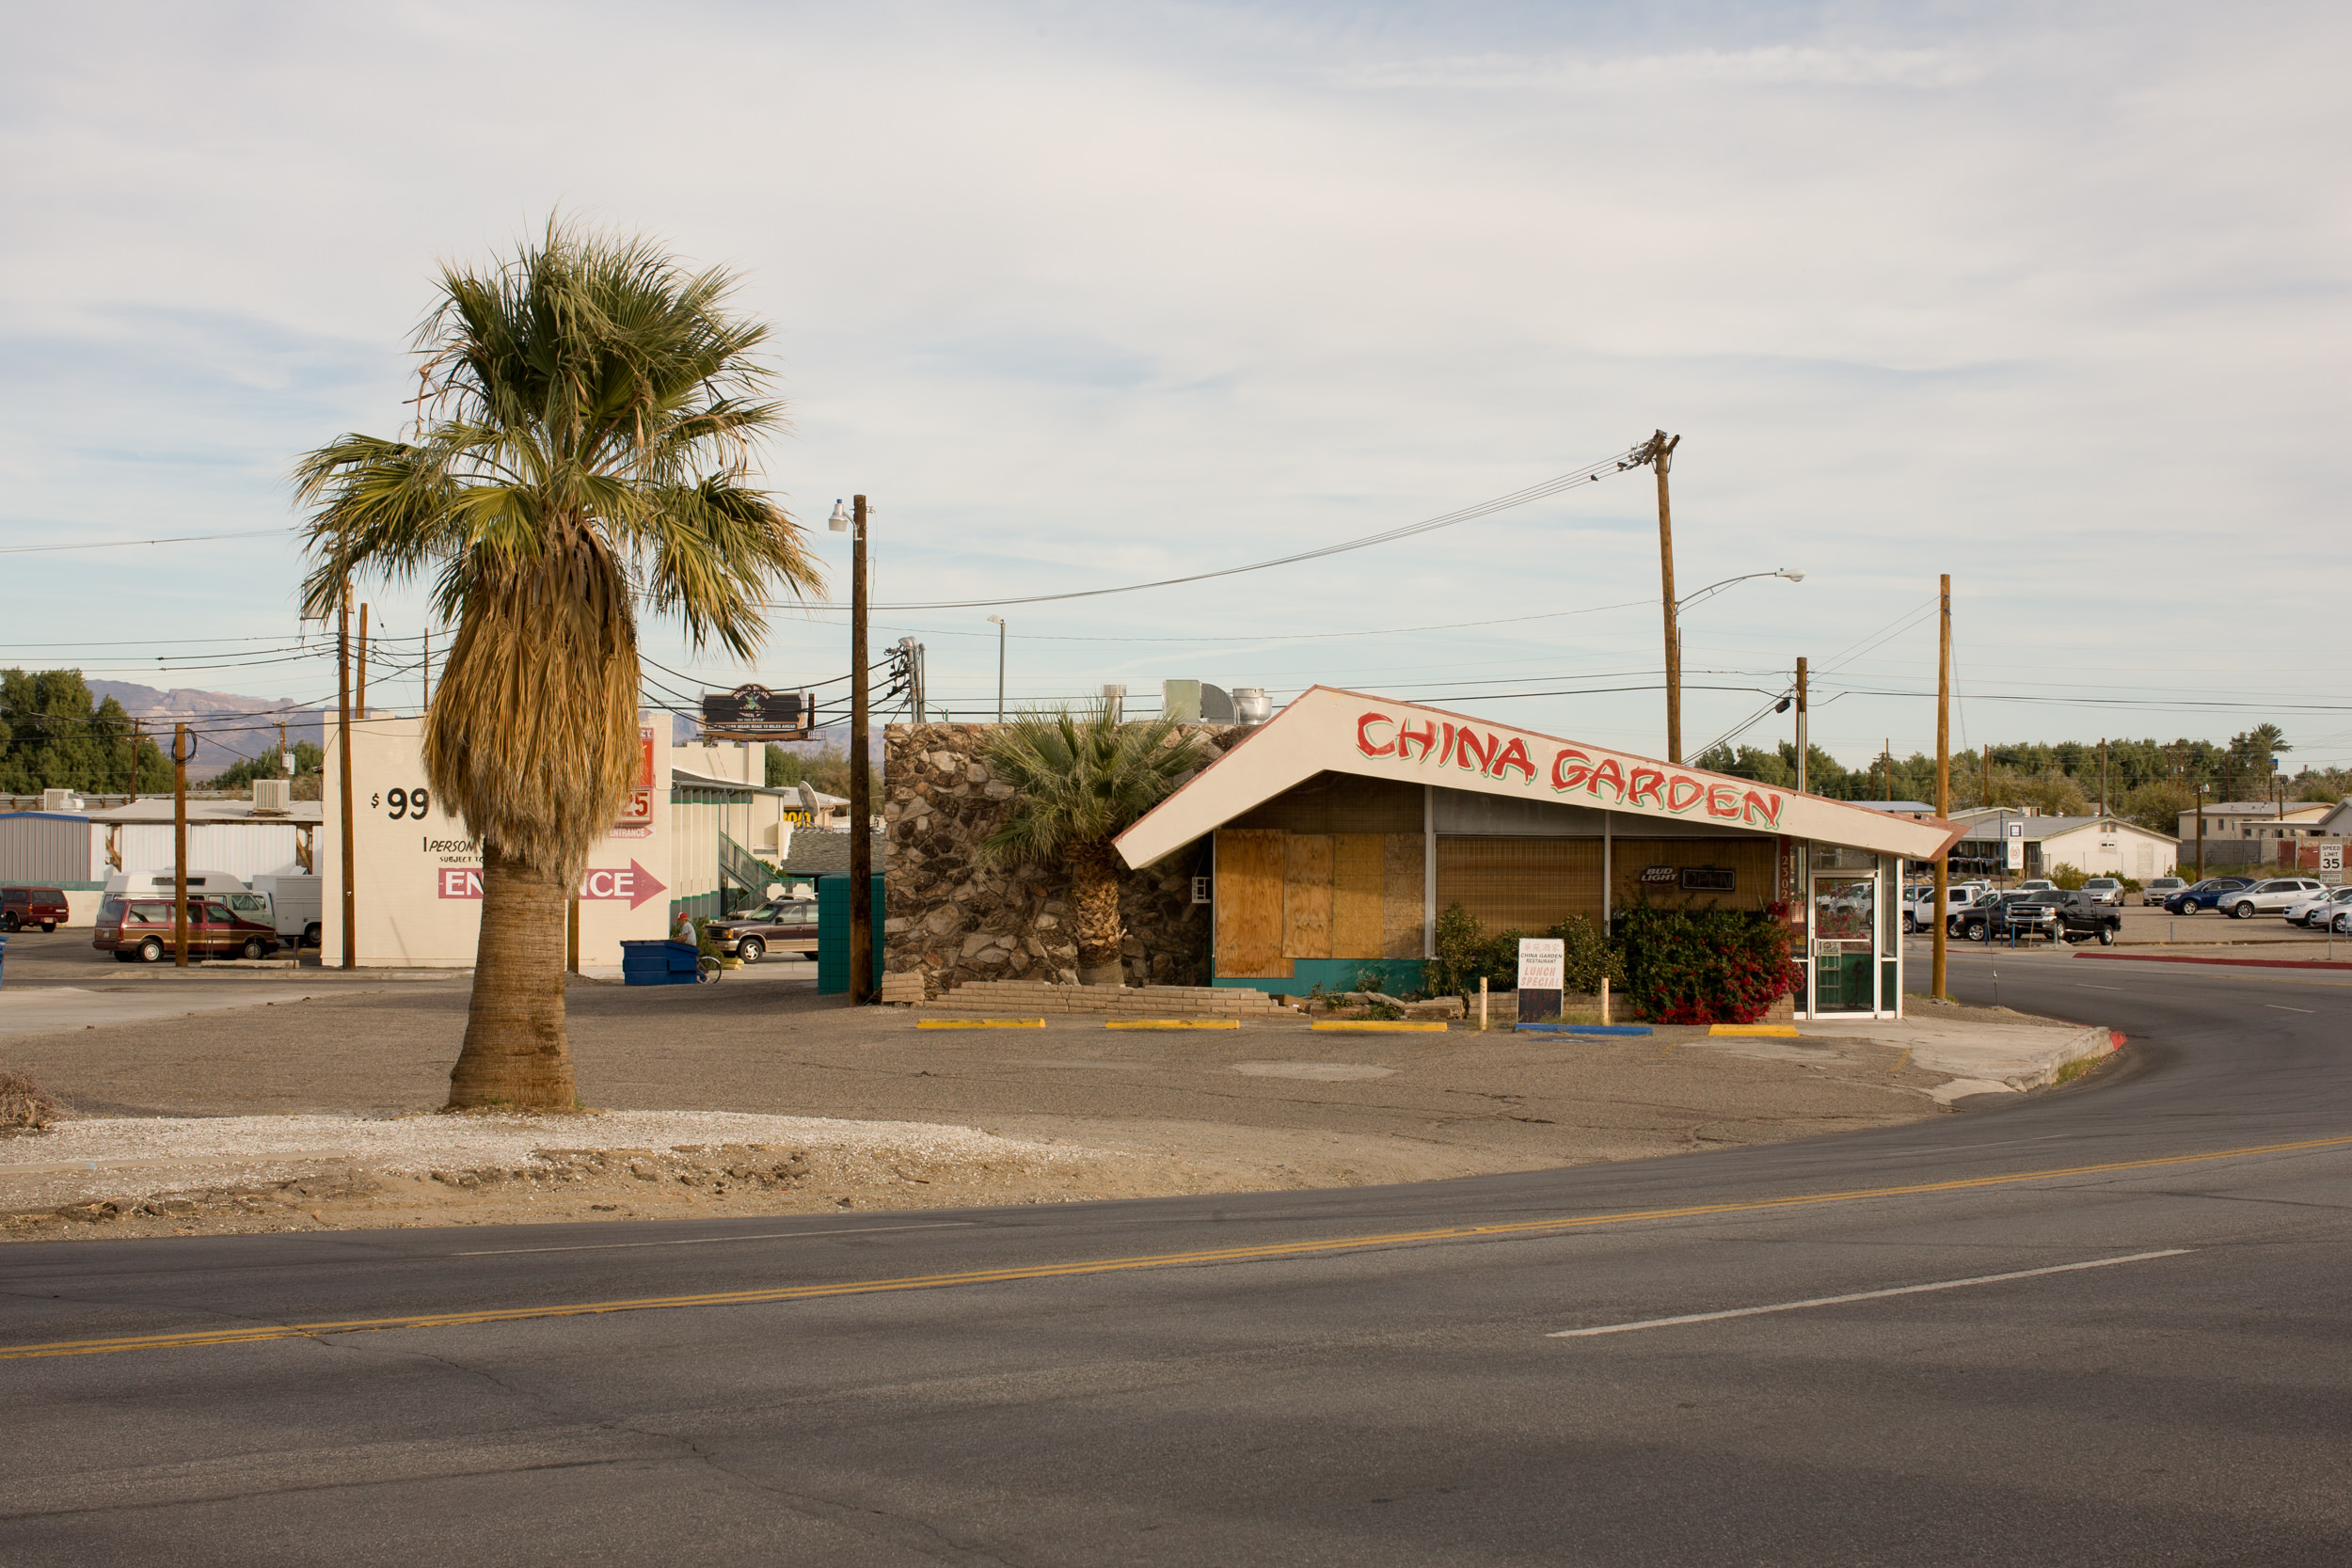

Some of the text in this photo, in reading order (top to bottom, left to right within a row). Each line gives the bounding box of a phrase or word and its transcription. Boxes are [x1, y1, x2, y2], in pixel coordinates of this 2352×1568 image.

[1357, 711, 1783, 830] CHINA GARDEN
[2323, 858, 2340, 868] 35
[1685, 871, 1732, 888] OPEN
[1524, 966, 1556, 976] LUNCH
[1520, 976, 1559, 987] SPECIAL
